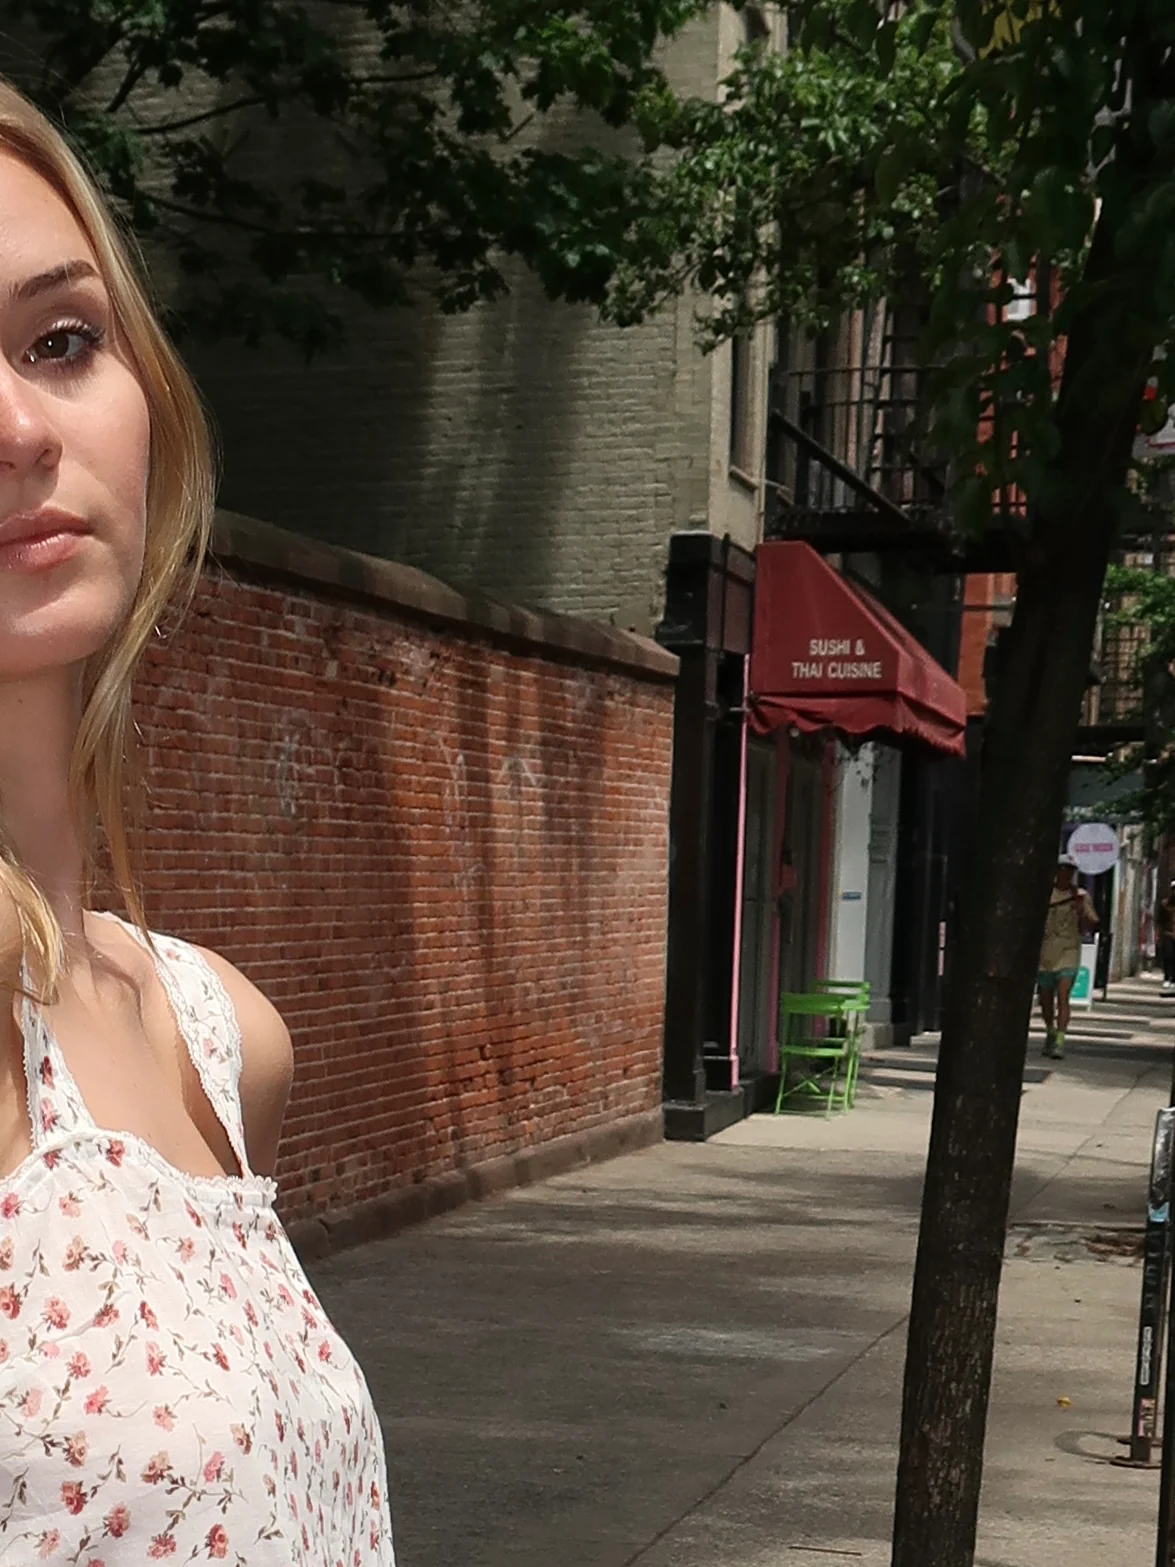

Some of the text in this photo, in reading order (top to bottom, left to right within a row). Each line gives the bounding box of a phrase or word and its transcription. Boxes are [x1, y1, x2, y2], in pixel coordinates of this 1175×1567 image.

[809, 639, 865, 656] SUSHI &
[791, 661, 882, 678] THAI CUISINE
